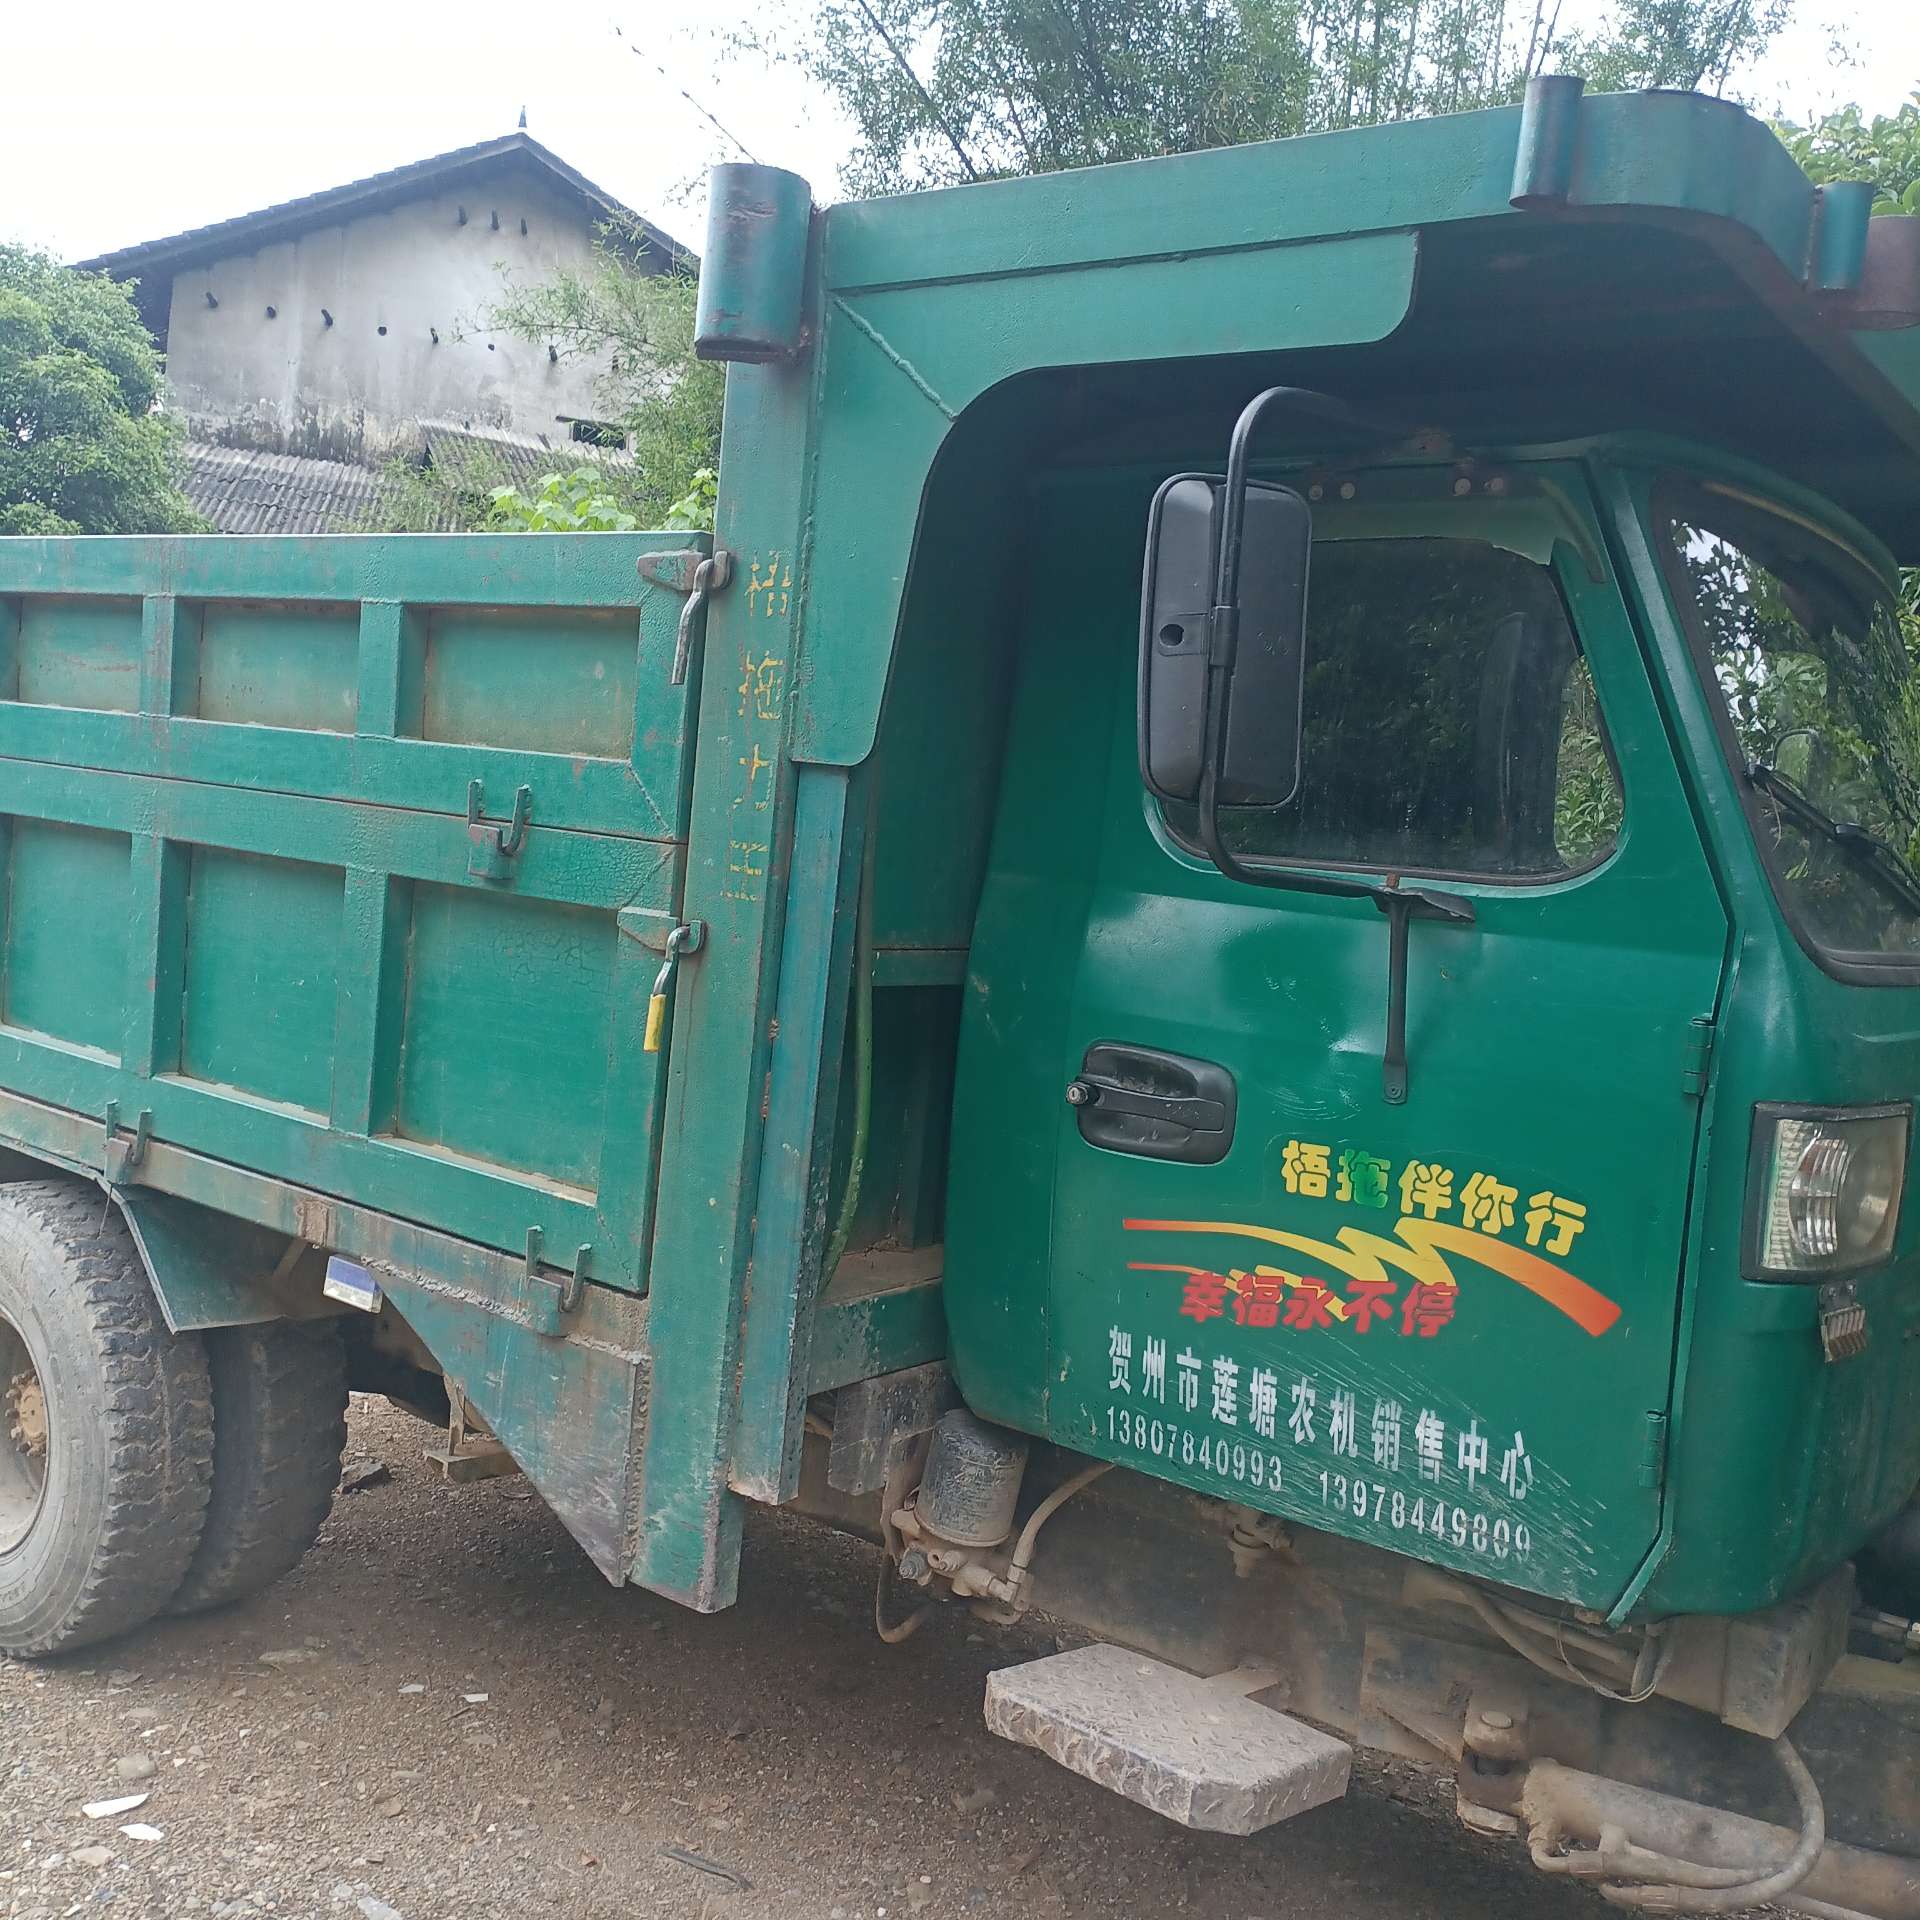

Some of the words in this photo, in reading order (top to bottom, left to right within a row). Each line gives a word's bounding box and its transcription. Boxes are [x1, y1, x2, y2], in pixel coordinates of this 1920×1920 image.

[1281, 1140, 1588, 1256] 梧拖伴你行
[1179, 1270, 1460, 1338] 幸福永不停
[1106, 1406, 1283, 1493] 13807840993
[1108, 1325, 1535, 1501] 贺州市莲塘农机销售中心
